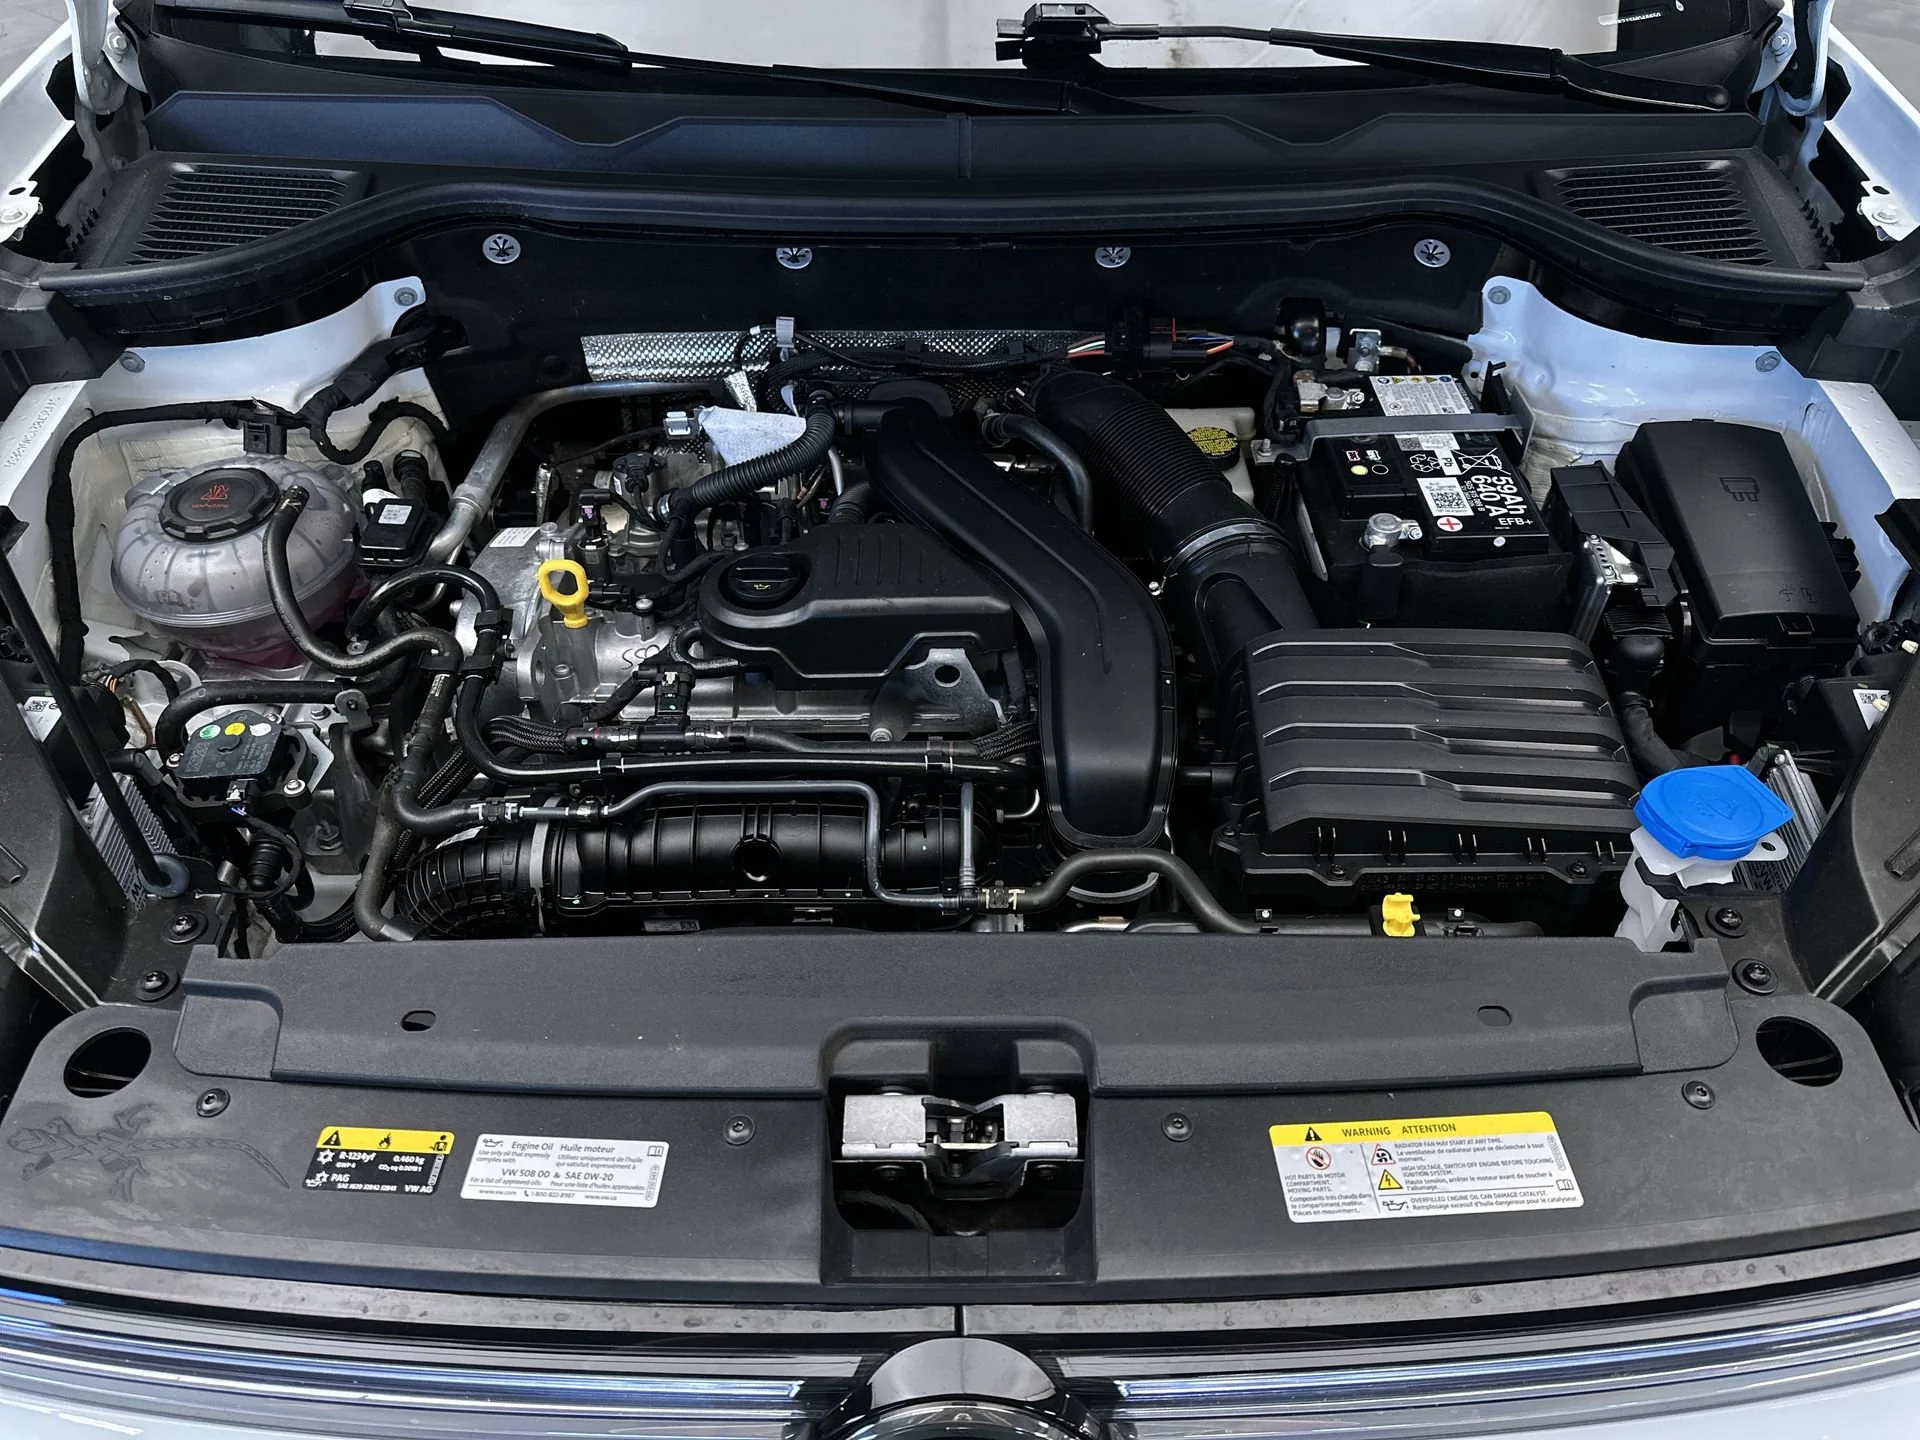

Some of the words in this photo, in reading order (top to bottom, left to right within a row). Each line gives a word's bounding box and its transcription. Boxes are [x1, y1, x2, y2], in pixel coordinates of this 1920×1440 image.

[1441, 457, 1453, 468] Pb
[1470, 475, 1501, 502] 640
[1492, 476, 1528, 515] 59Ah
[1484, 504, 1509, 517] A
[1498, 517, 1533, 526] EFB+
[1341, 1126, 1391, 1137] WARNING
[1401, 1123, 1457, 1135] ATTENTION
[512, 1141, 540, 1151] Engine
[541, 1142, 554, 1151] Oil
[560, 1143, 582, 1152] Huile
[584, 1144, 615, 1153] moteur
[1405, 1147, 1436, 1155] ventilateur
[1473, 1145, 1486, 1153] peut
[339, 1151, 376, 1163] R-1234yf
[415, 1156, 425, 1165] kg
[580, 1155, 616, 1163] uniquement
[1479, 1160, 1500, 1168] ENGINE
[1524, 1157, 1554, 1165] TOUCHING
[330, 1173, 350, 1182] PAG
[501, 1168, 519, 1177] VW
[519, 1169, 537, 1177] 508
[537, 1170, 551, 1178] 00
[553, 1171, 562, 1179] &
[565, 1171, 583, 1180] SAE
[583, 1172, 615, 1181] 0W-20
[404, 1185, 420, 1193] VW
[419, 1186, 434, 1194] AG
[1289, 1195, 1325, 1203] Composants
[1298, 1201, 1341, 1210] compartiment
[1412, 1202, 1449, 1210] Remplissage
